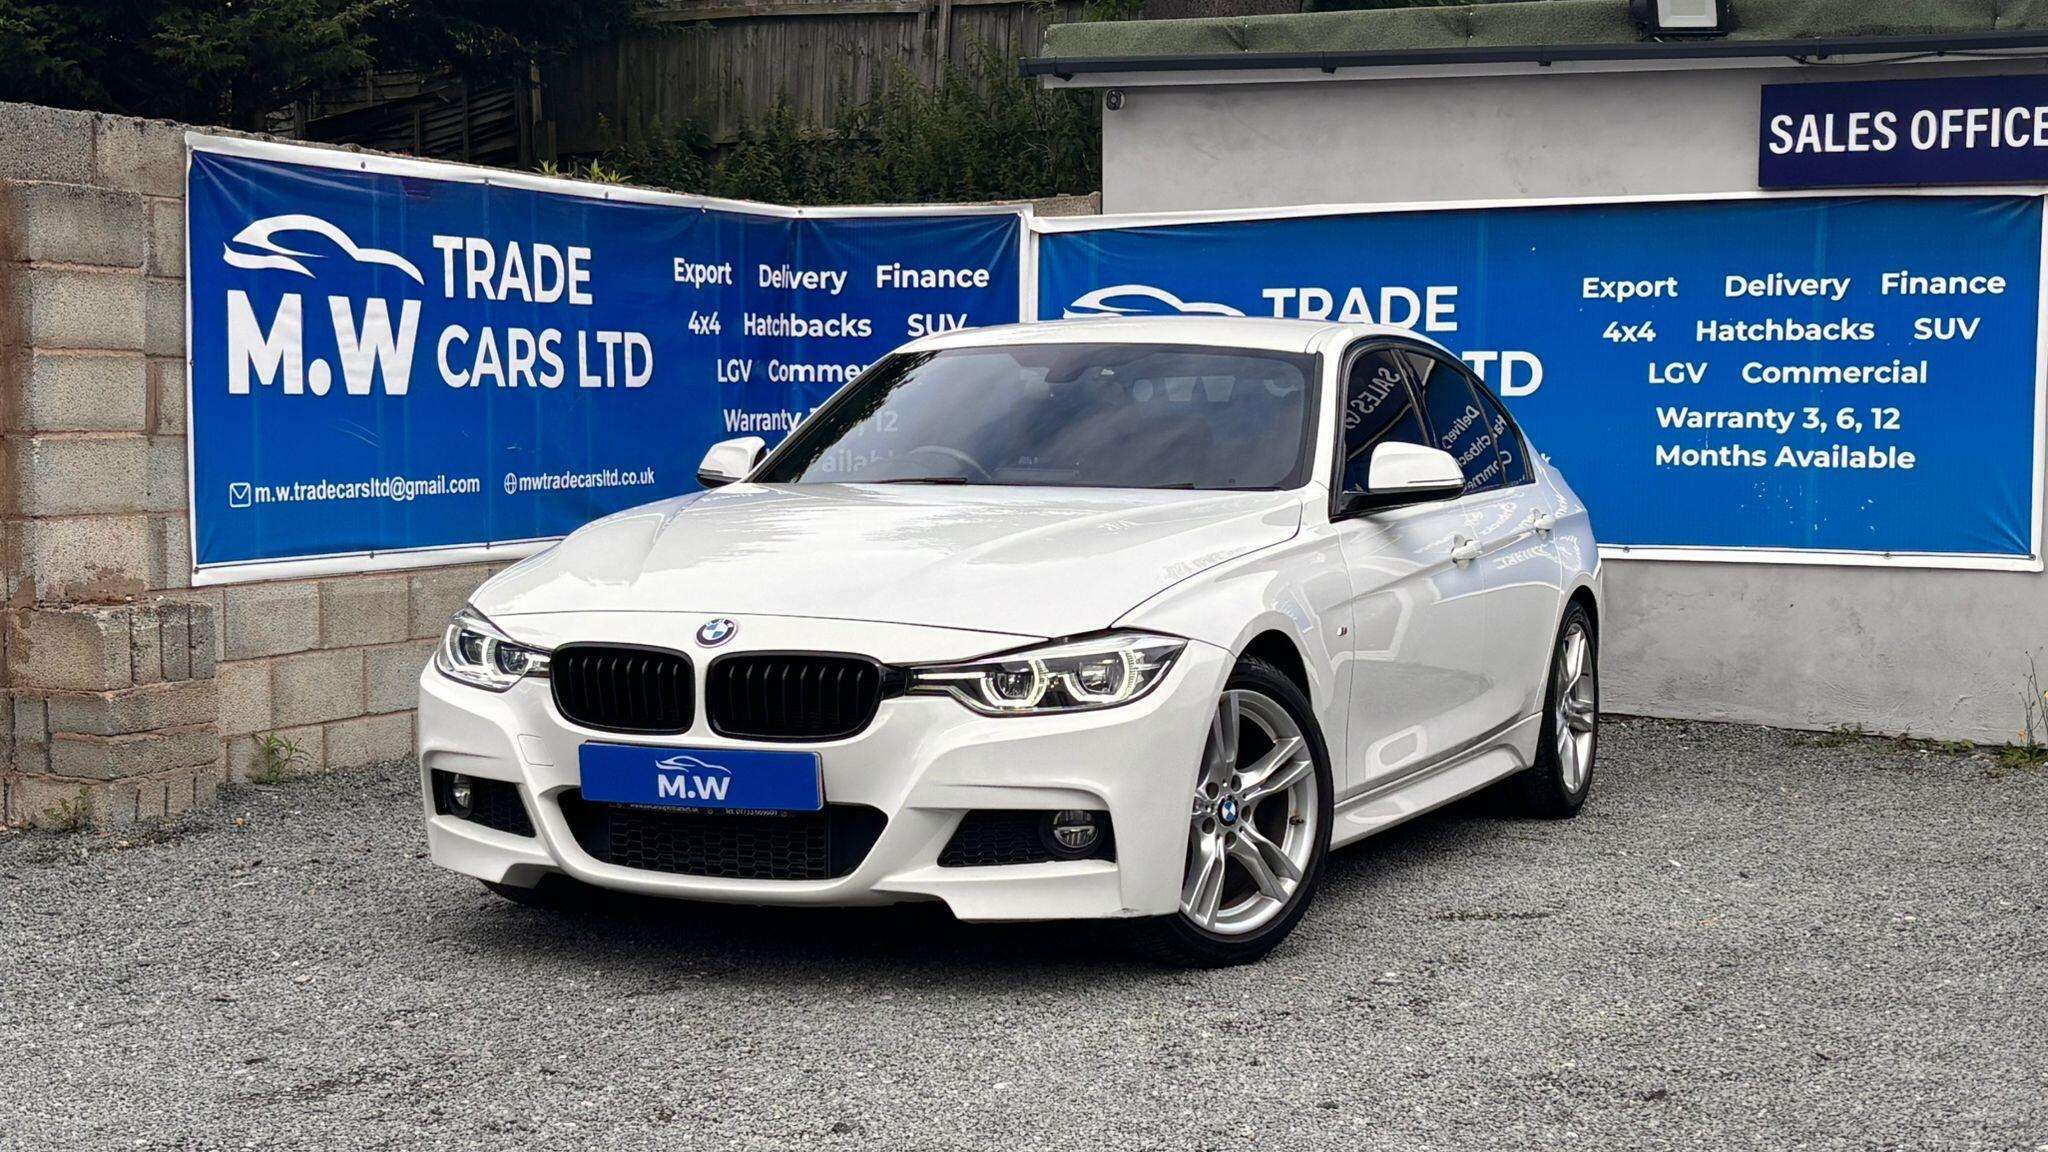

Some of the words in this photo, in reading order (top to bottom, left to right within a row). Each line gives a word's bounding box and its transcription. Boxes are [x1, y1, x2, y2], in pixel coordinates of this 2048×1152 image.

[1769, 111, 1897, 154] SALES
[1911, 106, 2048, 150] OFFICE
[432, 235, 593, 305] TRADE
[674, 257, 732, 289] Export
[759, 265, 848, 295] Delivery
[876, 263, 990, 289] Finance
[1582, 276, 1678, 303] Export
[1725, 272, 1850, 302] Delivery
[1881, 270, 2007, 295] Finance
[688, 310, 721, 335] 4x4
[744, 312, 872, 338] Hatchbacks
[907, 313, 968, 337] SUV
[1262, 286, 1458, 331] TRADE
[227, 289, 422, 396] M.W
[1602, 320, 1657, 343] 4x4
[1696, 317, 1875, 342] Hatchbacks
[1913, 317, 1981, 341] SUV
[437, 324, 565, 389] CARS
[578, 330, 653, 388] LTD
[717, 359, 752, 383] LGV
[1648, 362, 1708, 384] LGV
[1741, 360, 1928, 384] Commercial
[1462, 351, 1544, 397] TD
[724, 409, 801, 436] Warranty
[1656, 406, 1796, 434] Warranty
[1803, 407, 1828, 434] 3,
[1836, 407, 1862, 434] 6,
[1871, 407, 1901, 430] 12
[1655, 445, 1767, 468] Months
[1774, 445, 1916, 469] Available
[255, 475, 481, 503] m.w.tradecarsltd@gmail.com
[518, 466, 656, 493] mwtradecarsltd.co.uk
[657, 774, 731, 801] M.W
